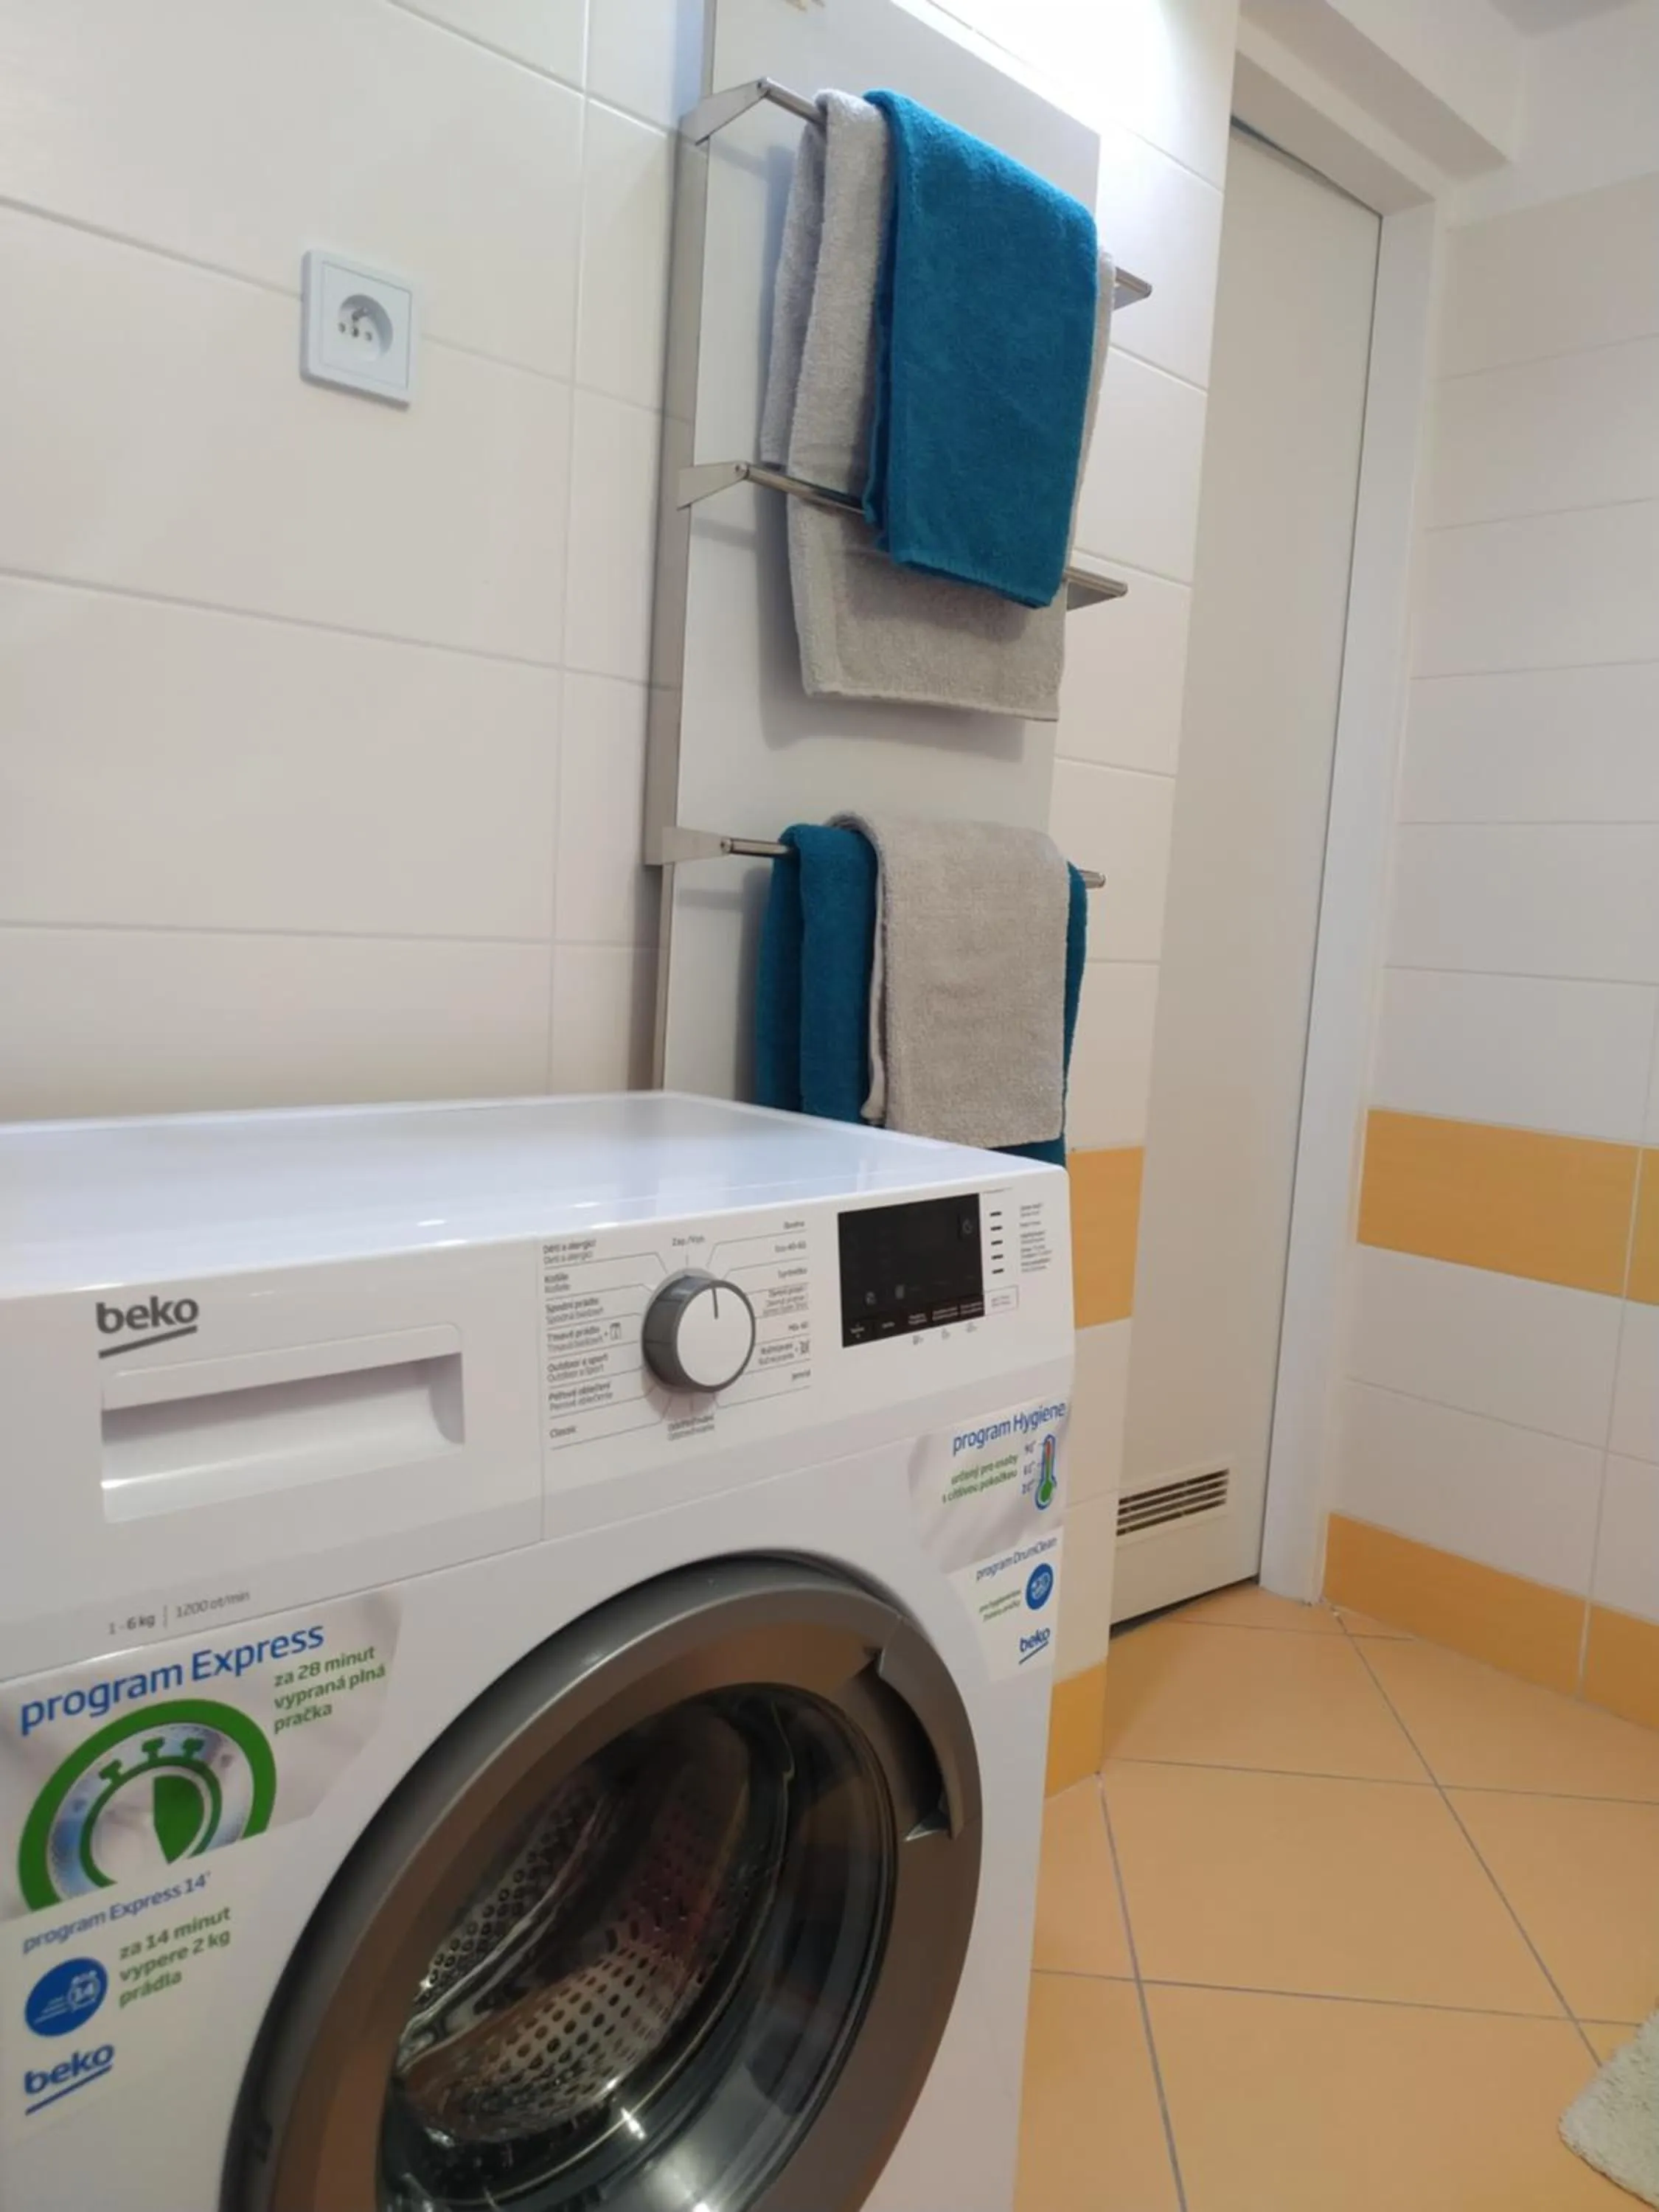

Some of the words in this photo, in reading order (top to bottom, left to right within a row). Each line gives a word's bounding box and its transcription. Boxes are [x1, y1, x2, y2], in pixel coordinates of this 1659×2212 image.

[95, 1295, 200, 1335] beko
[953, 1420, 1011, 1458] program
[1013, 1402, 1066, 1434] Hygiene
[175, 1599, 209, 1618] 1200
[1019, 1627, 1051, 1652] beko
[20, 1663, 184, 1736] program
[191, 1624, 324, 1682] Express
[273, 1672, 294, 1688] za
[297, 1662, 321, 1680] 28
[324, 1646, 376, 1672] minut
[273, 1675, 347, 1710] vypraná
[349, 1663, 386, 1690] plná
[273, 1703, 333, 1734] pračka
[23, 1912, 106, 1955] program
[109, 1885, 182, 1921] Express
[119, 1941, 142, 1960] za
[145, 1930, 170, 1950] 14
[173, 1907, 232, 1940] minut
[119, 1947, 189, 1983] vypere
[192, 1938, 206, 1955] 2
[208, 1930, 232, 1949] kg
[119, 1970, 183, 2010] prádla
[24, 2044, 115, 2095] beko
